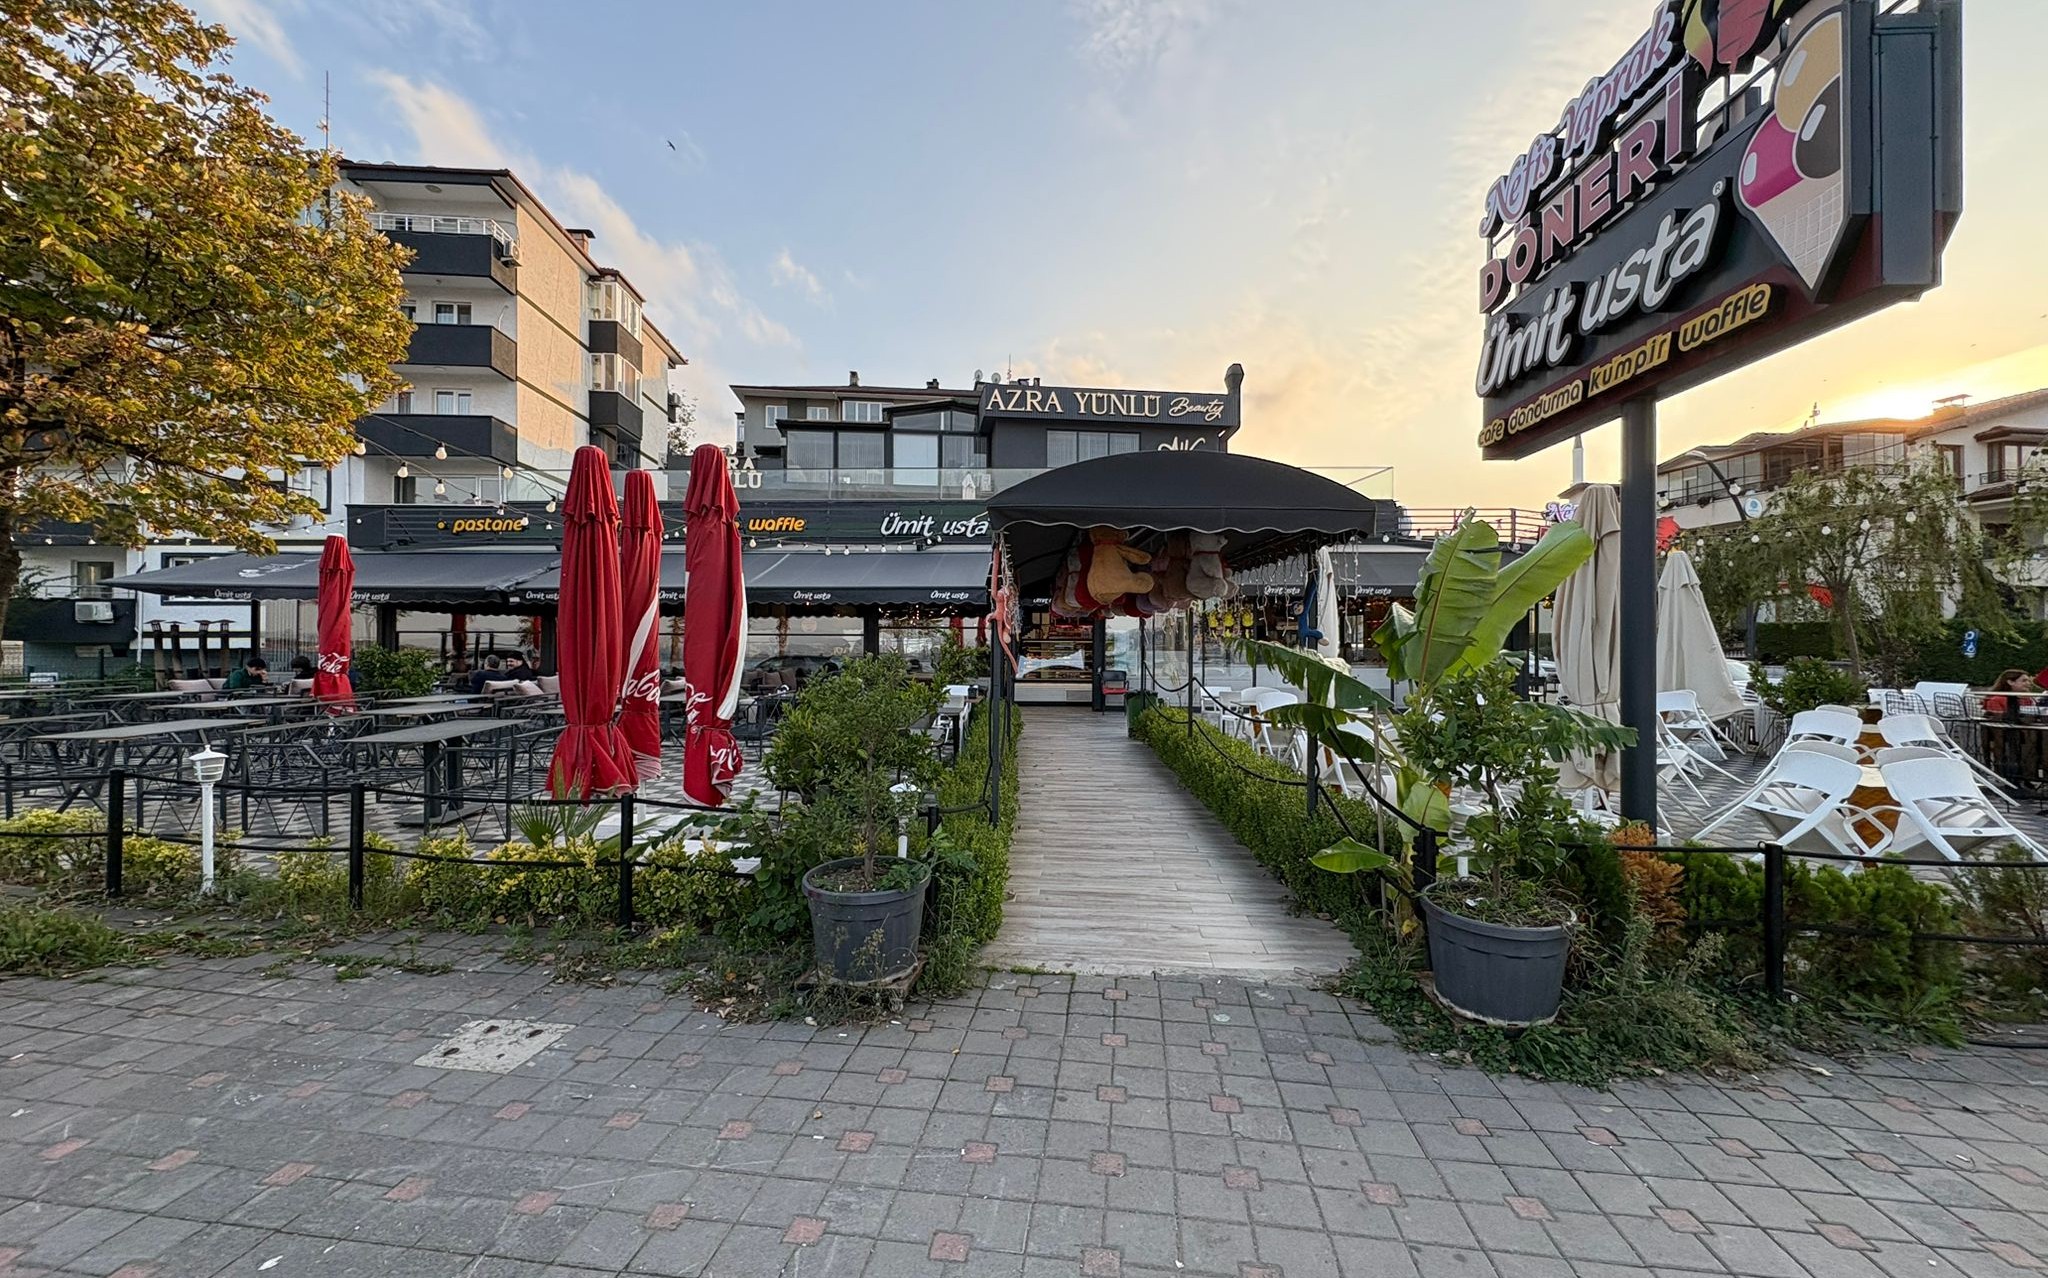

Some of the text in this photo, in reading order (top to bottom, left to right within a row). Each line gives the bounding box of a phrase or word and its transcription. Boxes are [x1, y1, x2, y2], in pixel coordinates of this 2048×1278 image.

[1480, 0, 1675, 238] Nefis Yaprak
[1480, 70, 1684, 314] DÖNERİ
[1476, 201, 1720, 396] Ümit usta
[1508, 379, 1583, 434] dondurma
[1588, 331, 1671, 398] kumpir
[1678, 283, 1771, 352] waffle
[984, 387, 1225, 422] AZRA YÜNLÜ Beauty
[452, 518, 524, 534] pastane
[749, 517, 805, 532] waffle
[880, 512, 988, 538] Ümit usta
[371, 593, 389, 602] usta
[813, 592, 831, 600] usta
[951, 592, 969, 600] usta
[1374, 587, 1392, 595] usta
